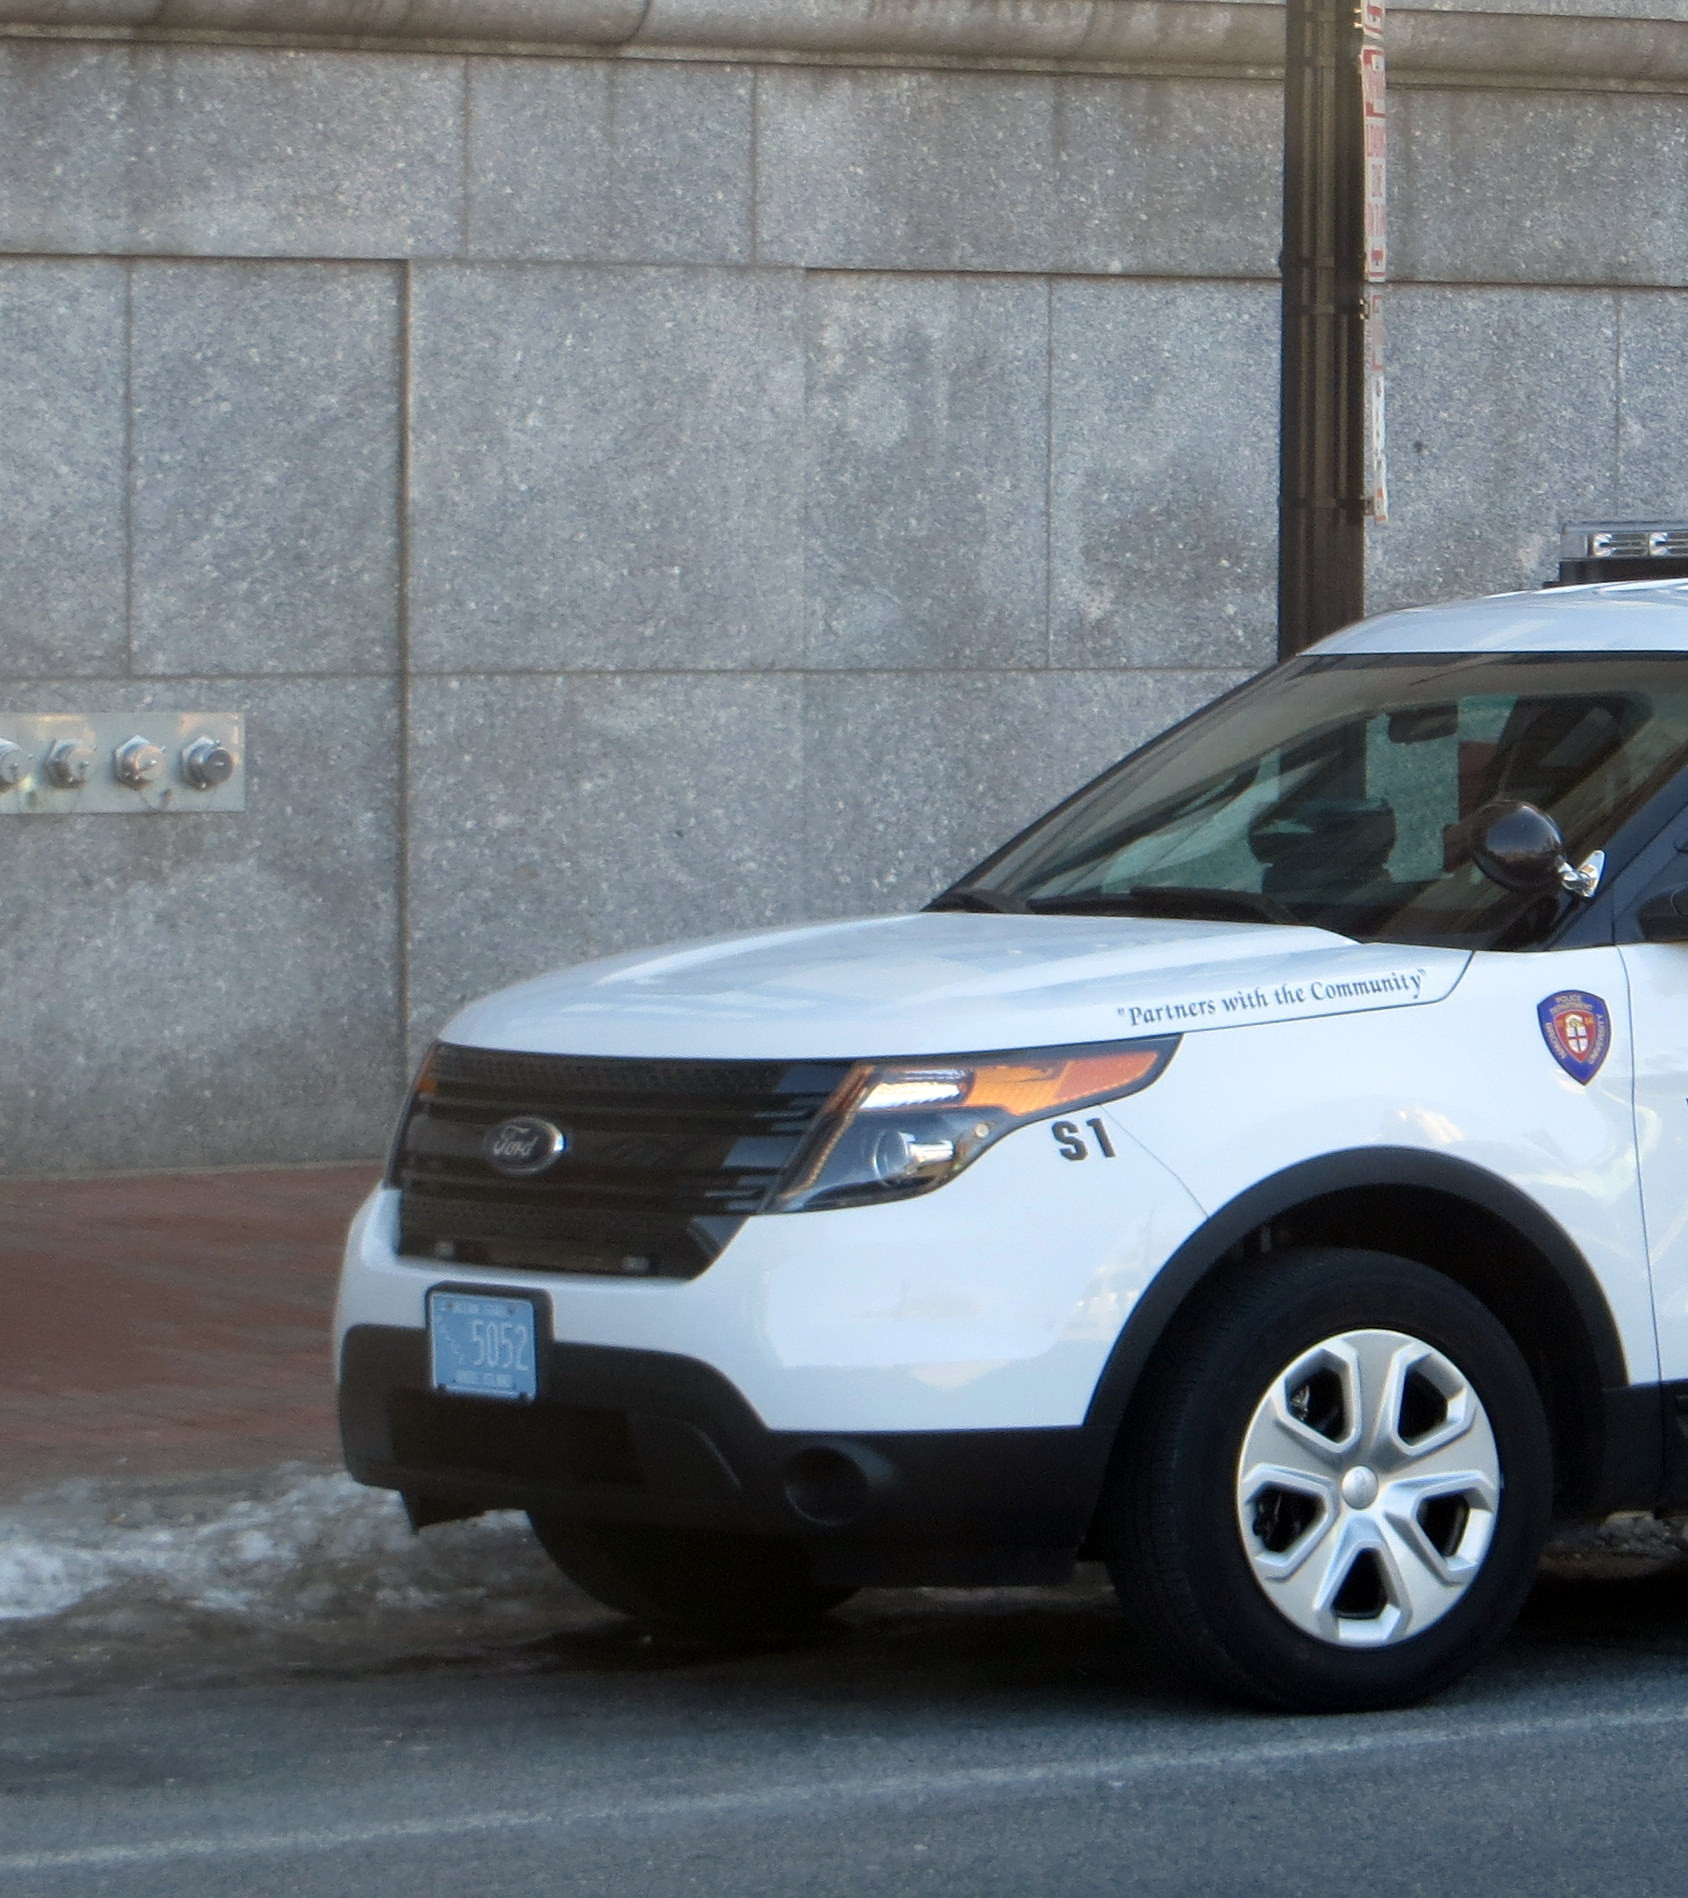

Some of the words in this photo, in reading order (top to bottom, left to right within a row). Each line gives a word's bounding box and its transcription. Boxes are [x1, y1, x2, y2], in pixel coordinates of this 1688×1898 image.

[1117, 996, 1216, 1027] "Partners
[1221, 986, 1269, 1014] with
[1273, 981, 1305, 1006] the
[1310, 967, 1427, 1000] Community"
[493, 1125, 540, 1156] Ford
[1051, 1117, 1117, 1161] S1
[472, 1318, 529, 1372] 5052
